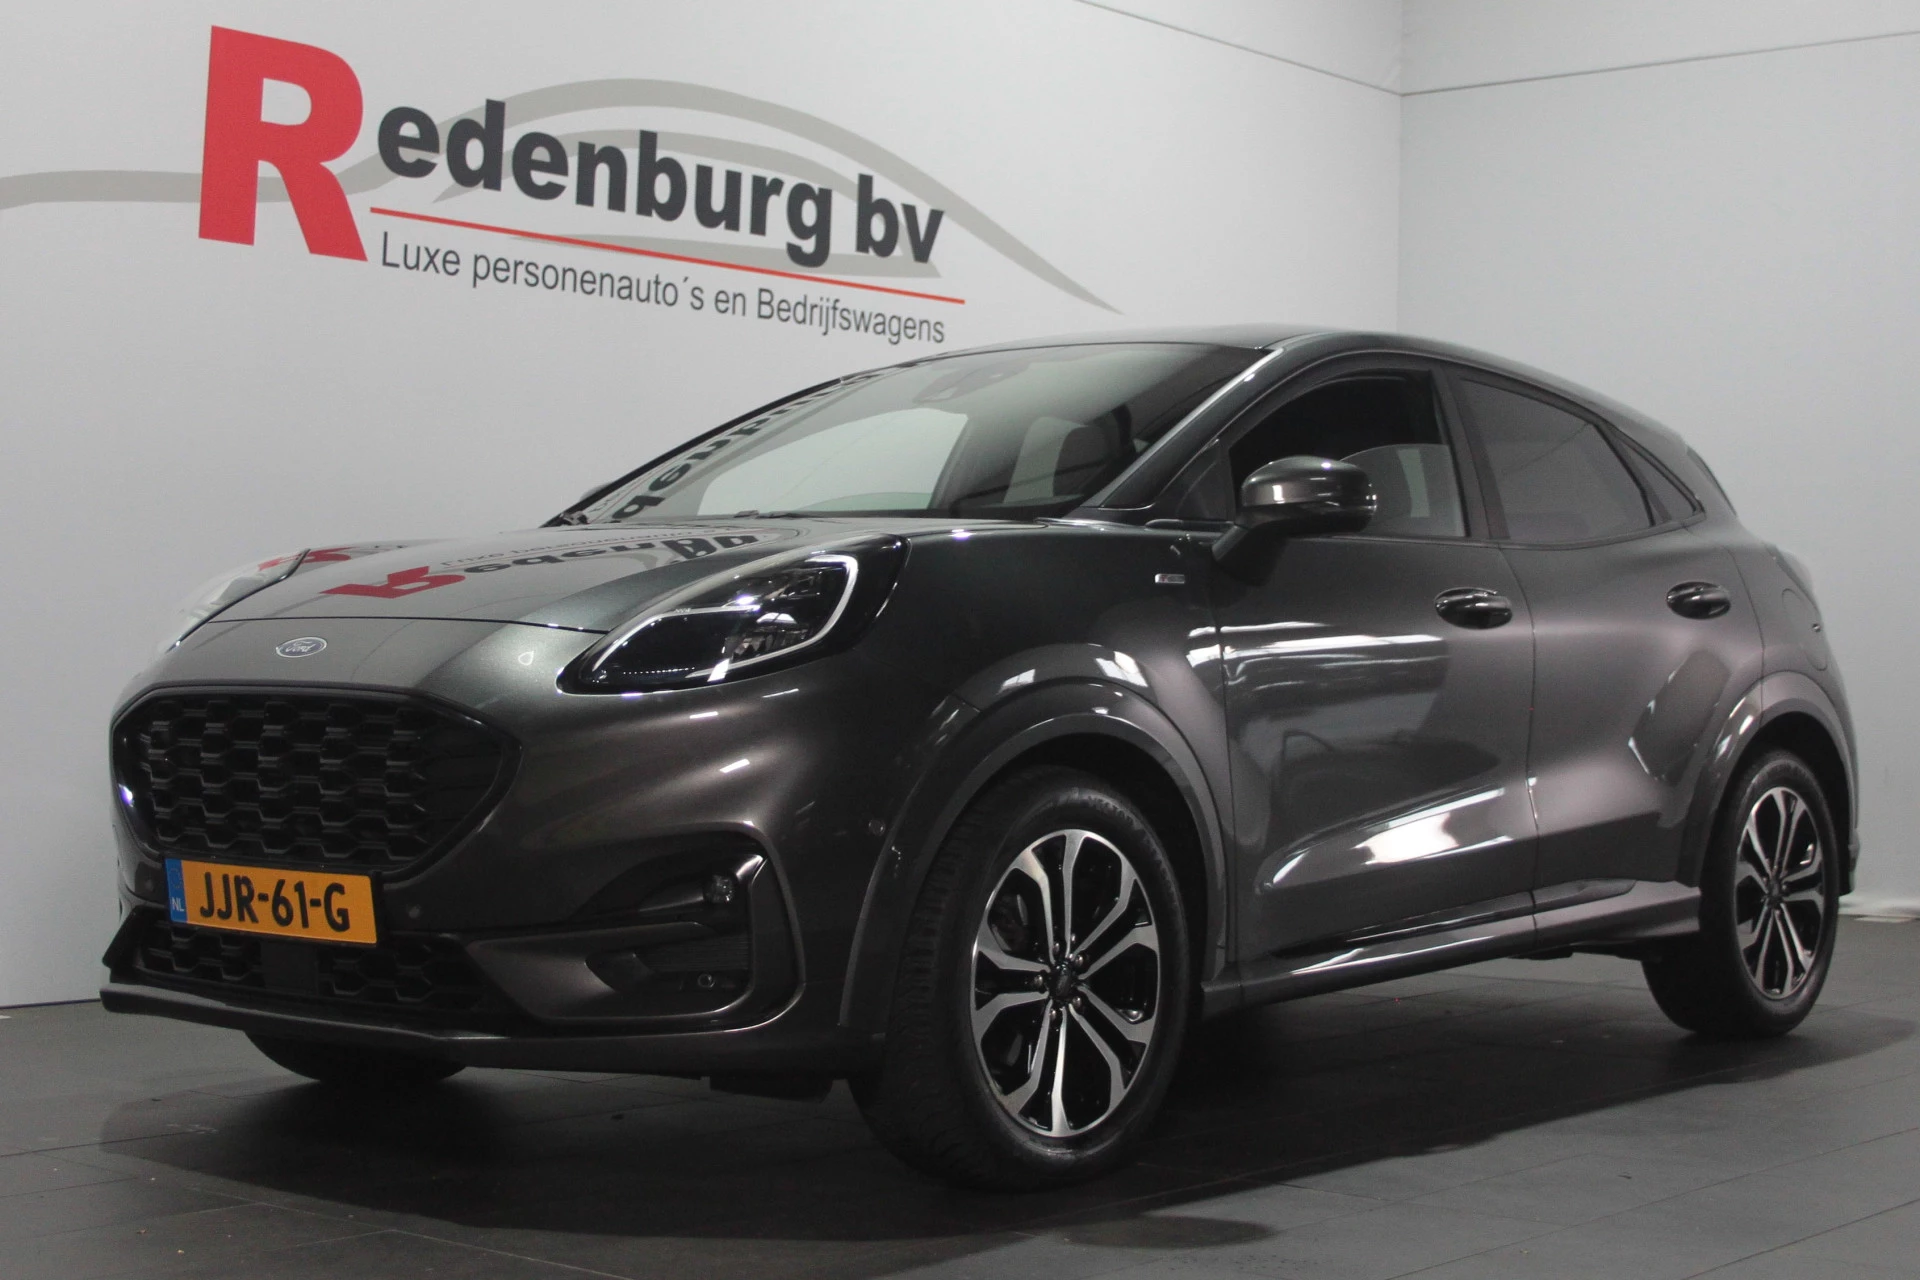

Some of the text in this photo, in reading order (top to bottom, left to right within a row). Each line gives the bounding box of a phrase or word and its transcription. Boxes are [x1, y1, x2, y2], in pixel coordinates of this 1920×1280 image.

[199, 26, 945, 269] Redenburg bv
[381, 231, 461, 276] Luxe
[714, 287, 747, 317] en
[757, 287, 945, 346] Bedrijfswagens
[171, 896, 185, 912] NL
[199, 871, 351, 933] JJR-61-G
